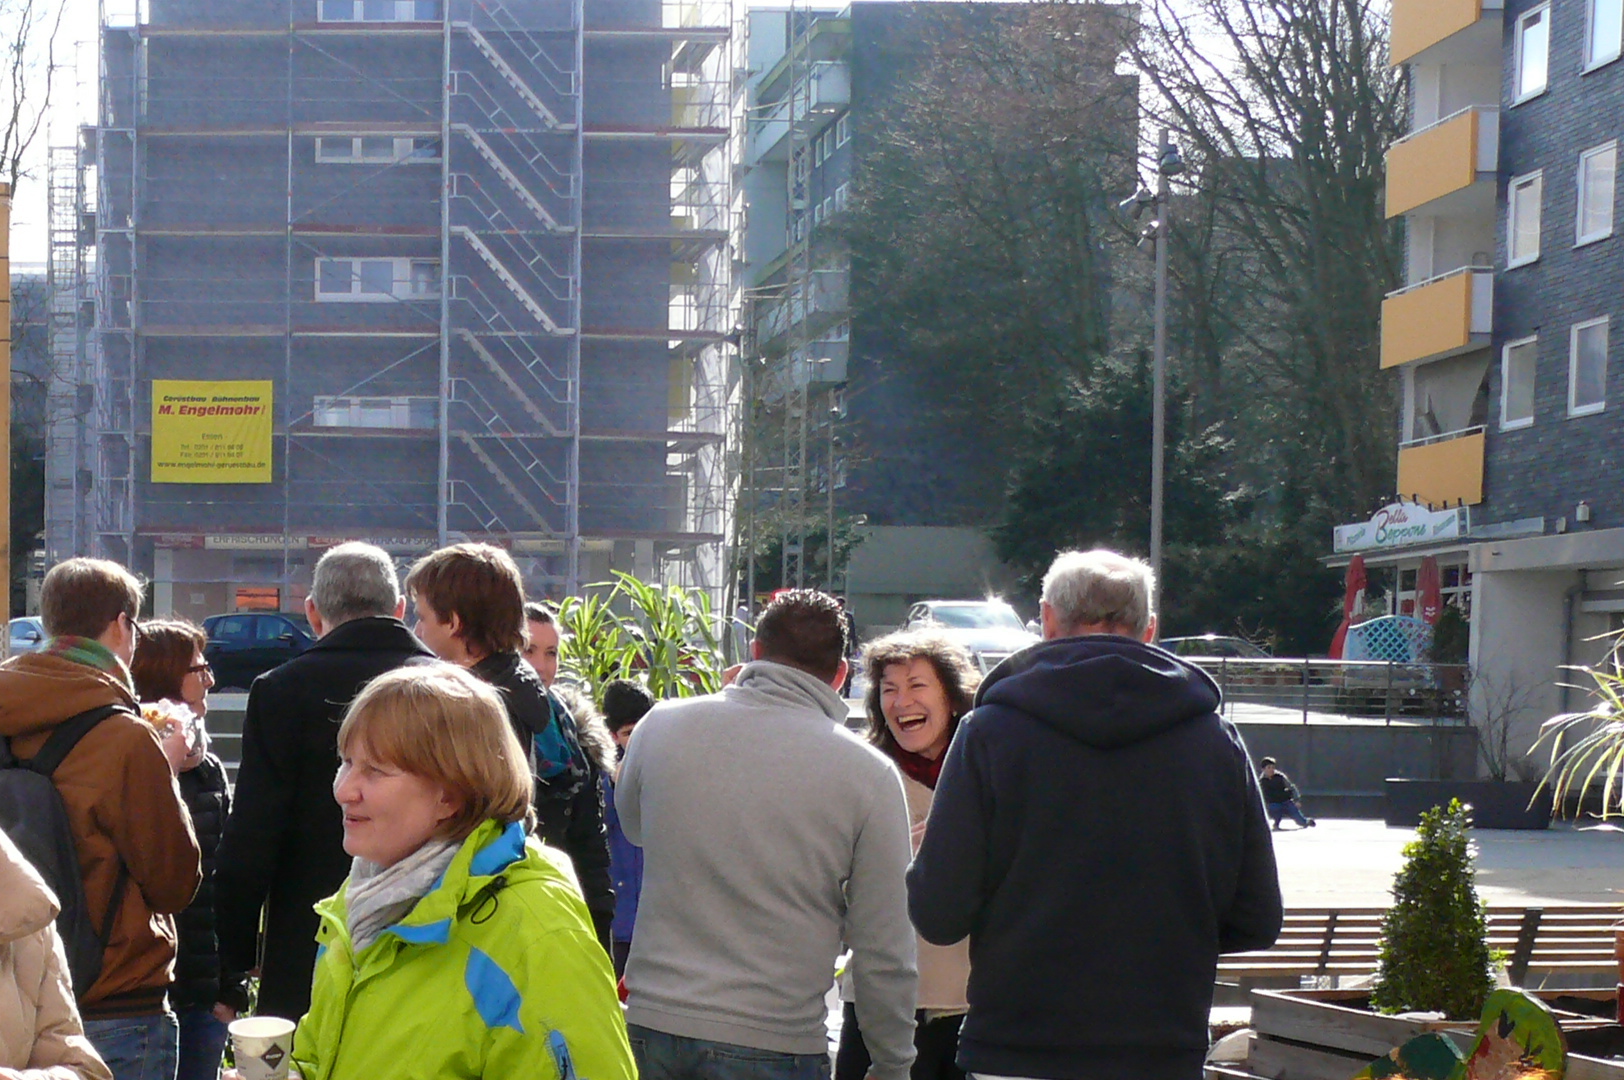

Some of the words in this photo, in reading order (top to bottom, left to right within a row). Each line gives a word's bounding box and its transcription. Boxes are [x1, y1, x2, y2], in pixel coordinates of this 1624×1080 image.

[158, 405, 175, 415] M.
[178, 404, 260, 417] Engelmohr
[213, 536, 300, 545] ERFRISCHUNGN
